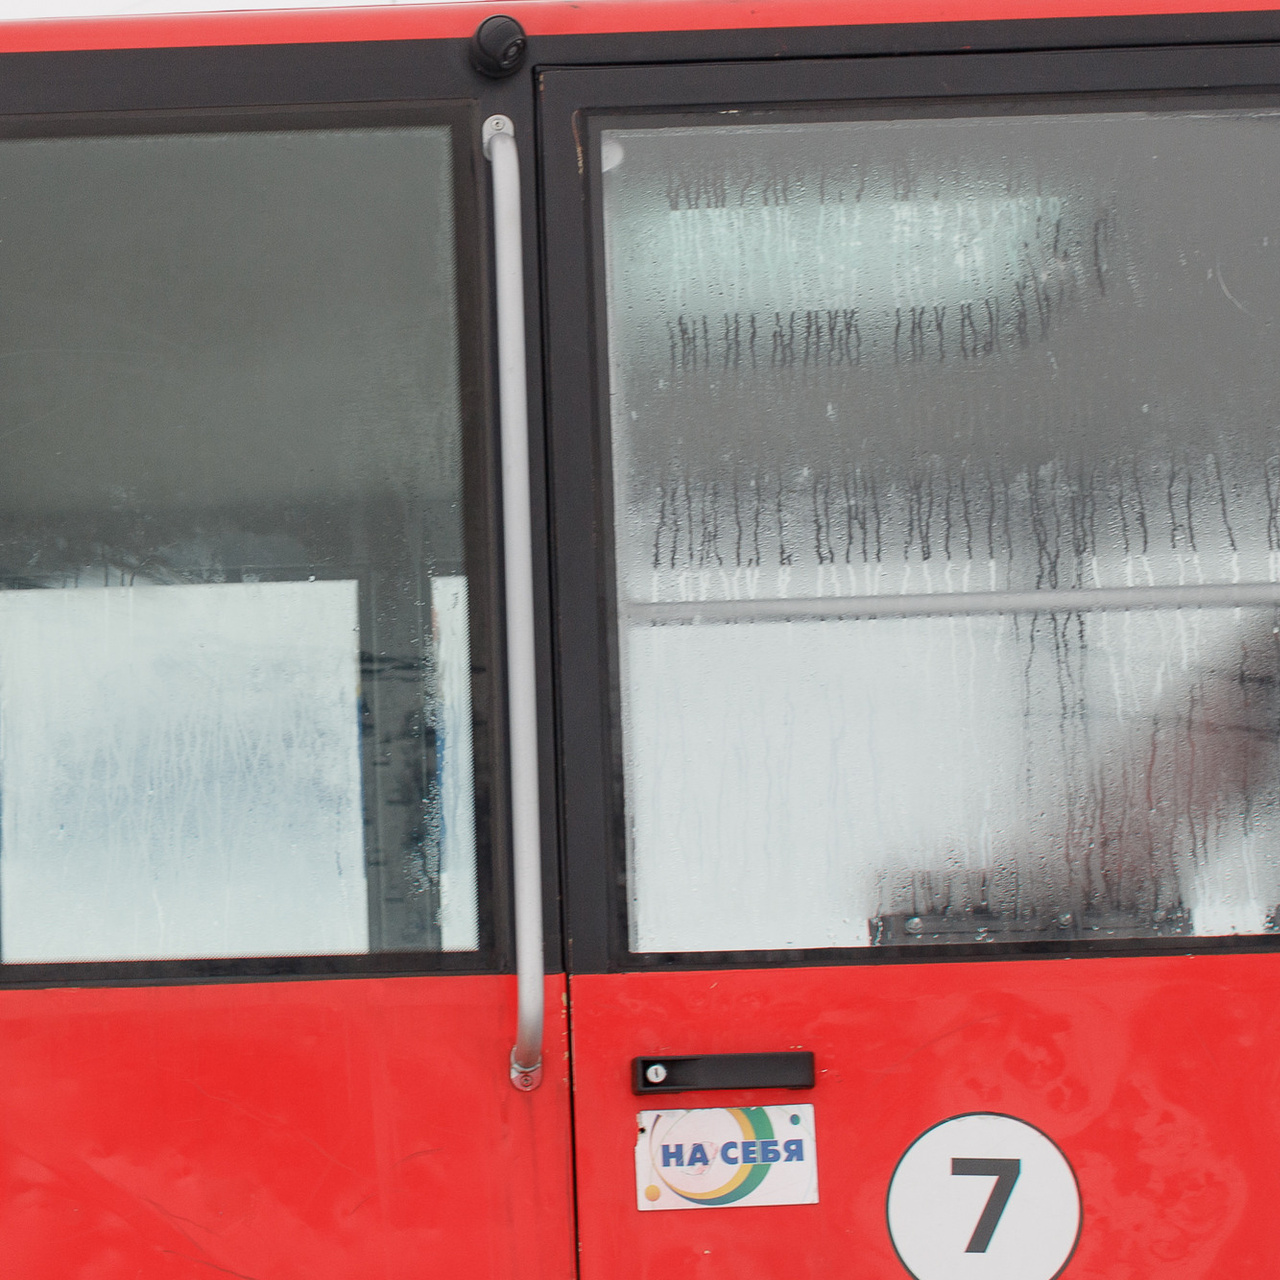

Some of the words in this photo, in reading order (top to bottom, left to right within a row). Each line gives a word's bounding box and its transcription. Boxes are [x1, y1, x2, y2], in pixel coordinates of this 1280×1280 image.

[661, 1143, 710, 1168] НА
[720, 1139, 805, 1165] СЕБЯ
[950, 1157, 1022, 1253] 7
